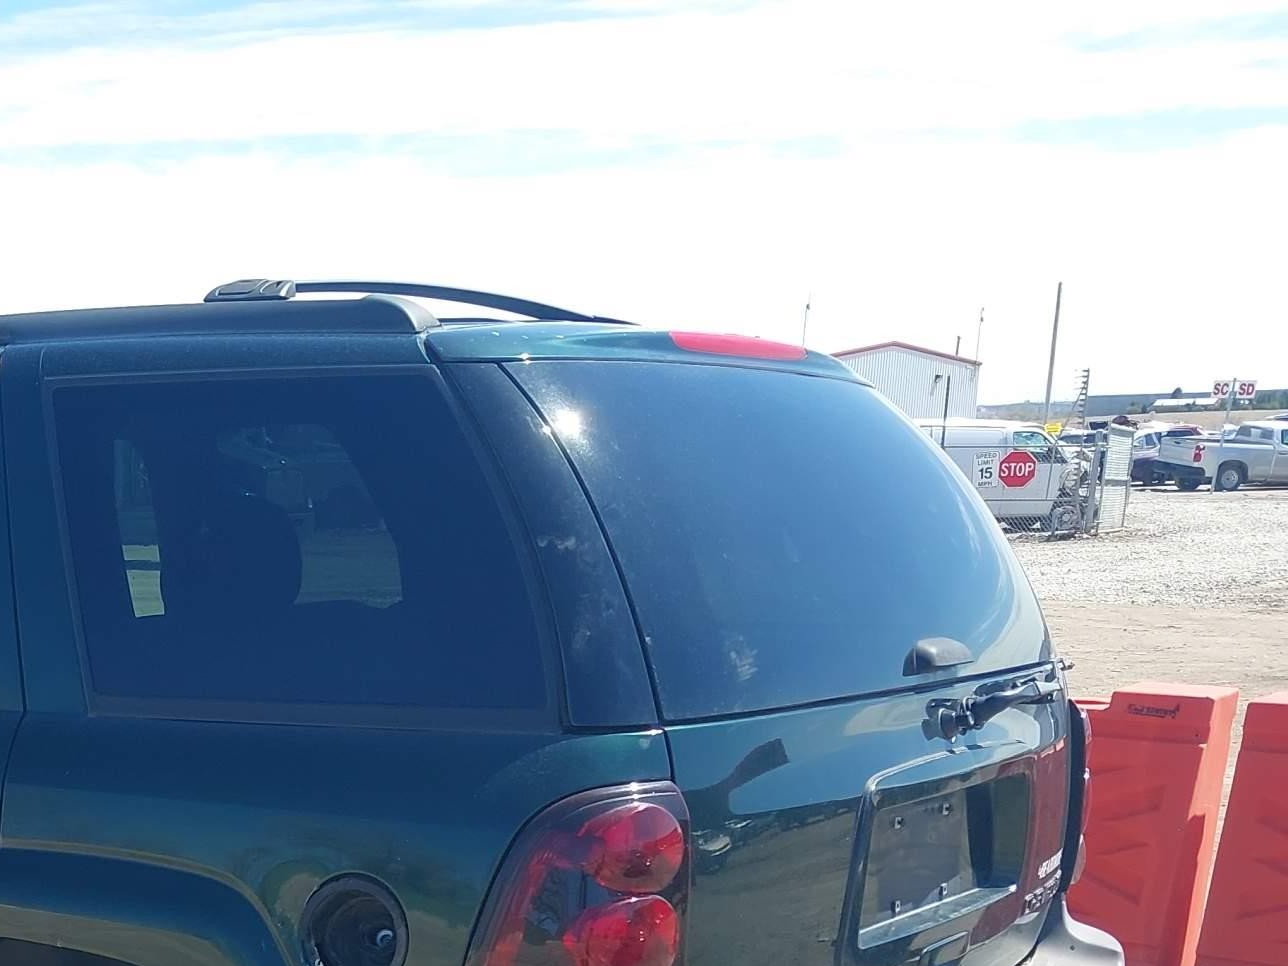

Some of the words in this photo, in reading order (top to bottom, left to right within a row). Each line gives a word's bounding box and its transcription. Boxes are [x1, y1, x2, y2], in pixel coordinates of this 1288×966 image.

[1213, 382, 1230, 396] SC
[1238, 382, 1255, 396] SD
[975, 452, 998, 460] SPEED
[978, 466, 993, 480] 15
[1000, 462, 1035, 477] STOP
